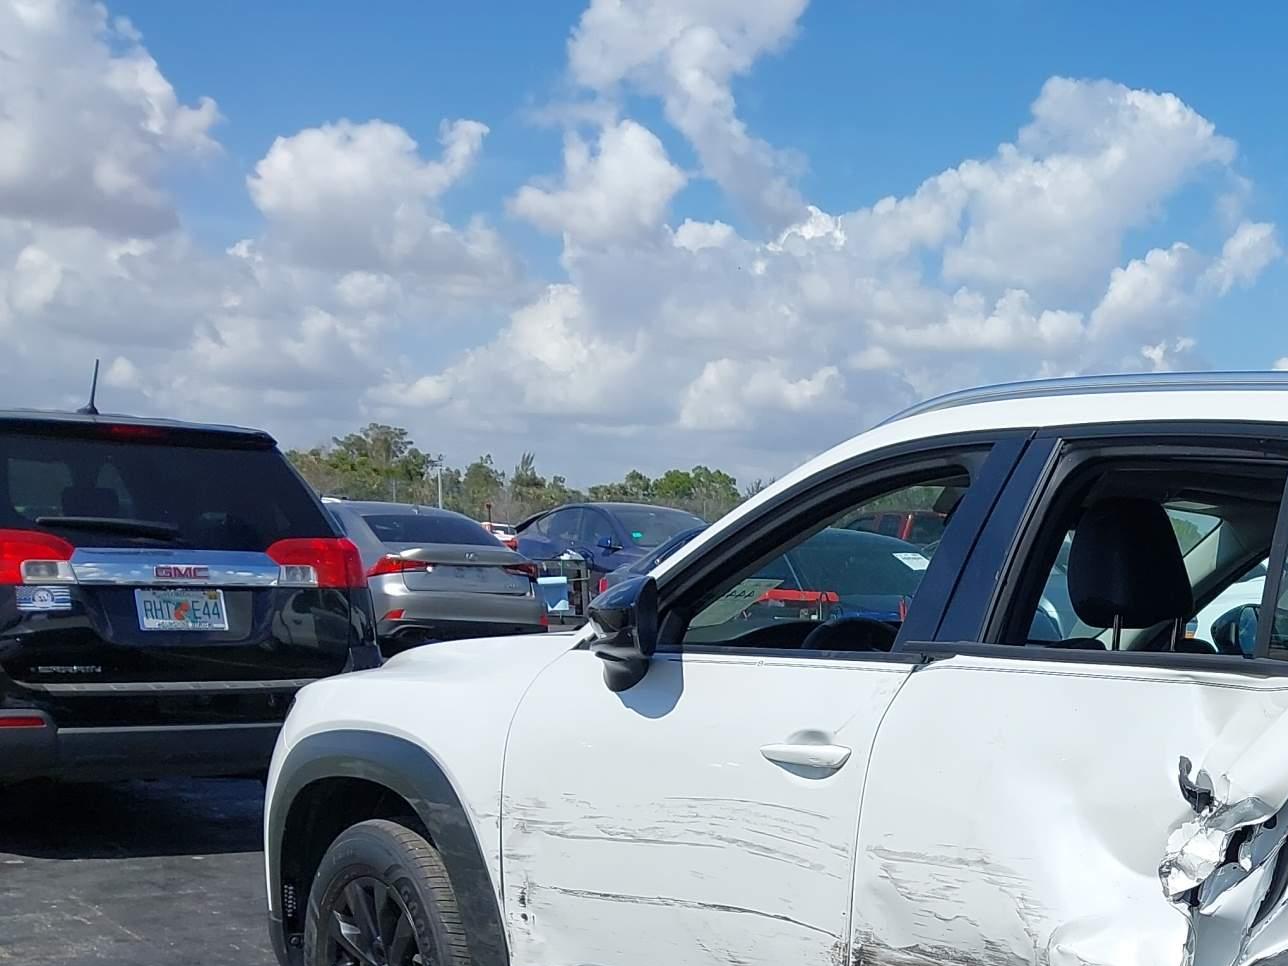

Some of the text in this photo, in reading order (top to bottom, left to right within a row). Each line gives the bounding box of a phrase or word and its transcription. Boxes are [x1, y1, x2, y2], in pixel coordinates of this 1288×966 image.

[155, 566, 209, 579] GMC
[144, 600, 221, 620] RHT E44
